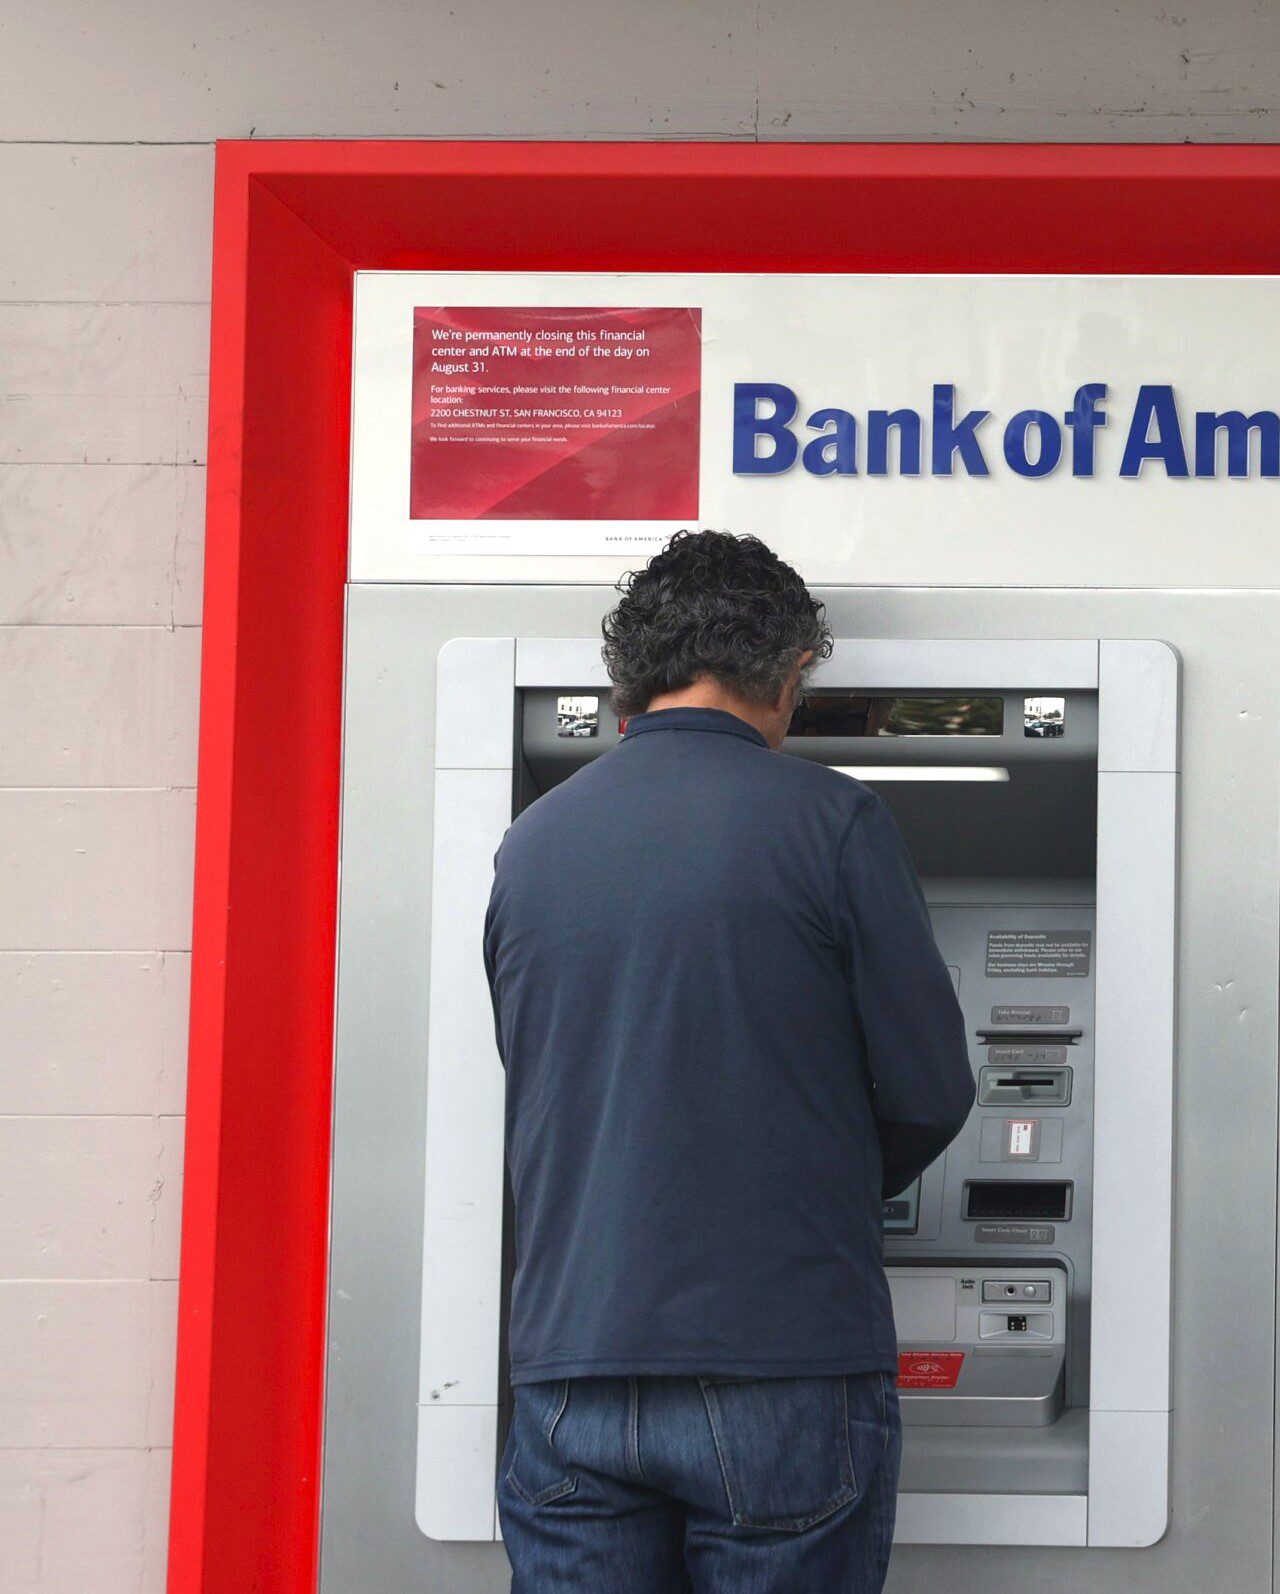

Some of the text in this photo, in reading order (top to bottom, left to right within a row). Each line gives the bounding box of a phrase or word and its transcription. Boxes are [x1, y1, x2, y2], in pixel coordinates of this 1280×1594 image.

[432, 329, 645, 344] We're permanently closing this financial
[431, 345, 650, 360] center and ATM at the end of the day on
[431, 361, 489, 375] August 31.
[431, 385, 443, 393] For
[445, 385, 476, 395] banking
[513, 385, 538, 395] please
[540, 386, 557, 394] visit
[558, 385, 572, 394] the
[573, 385, 609, 396] following
[611, 385, 644, 394] financial
[430, 409, 452, 417] 2200
[452, 409, 497, 417] CHESTNUT
[514, 409, 531, 417] SAN
[532, 409, 582, 418] FRANCISCO,
[583, 409, 595, 418] CA
[596, 409, 622, 418] 94123
[733, 384, 988, 476] Bank
[1003, 383, 1106, 477] of
